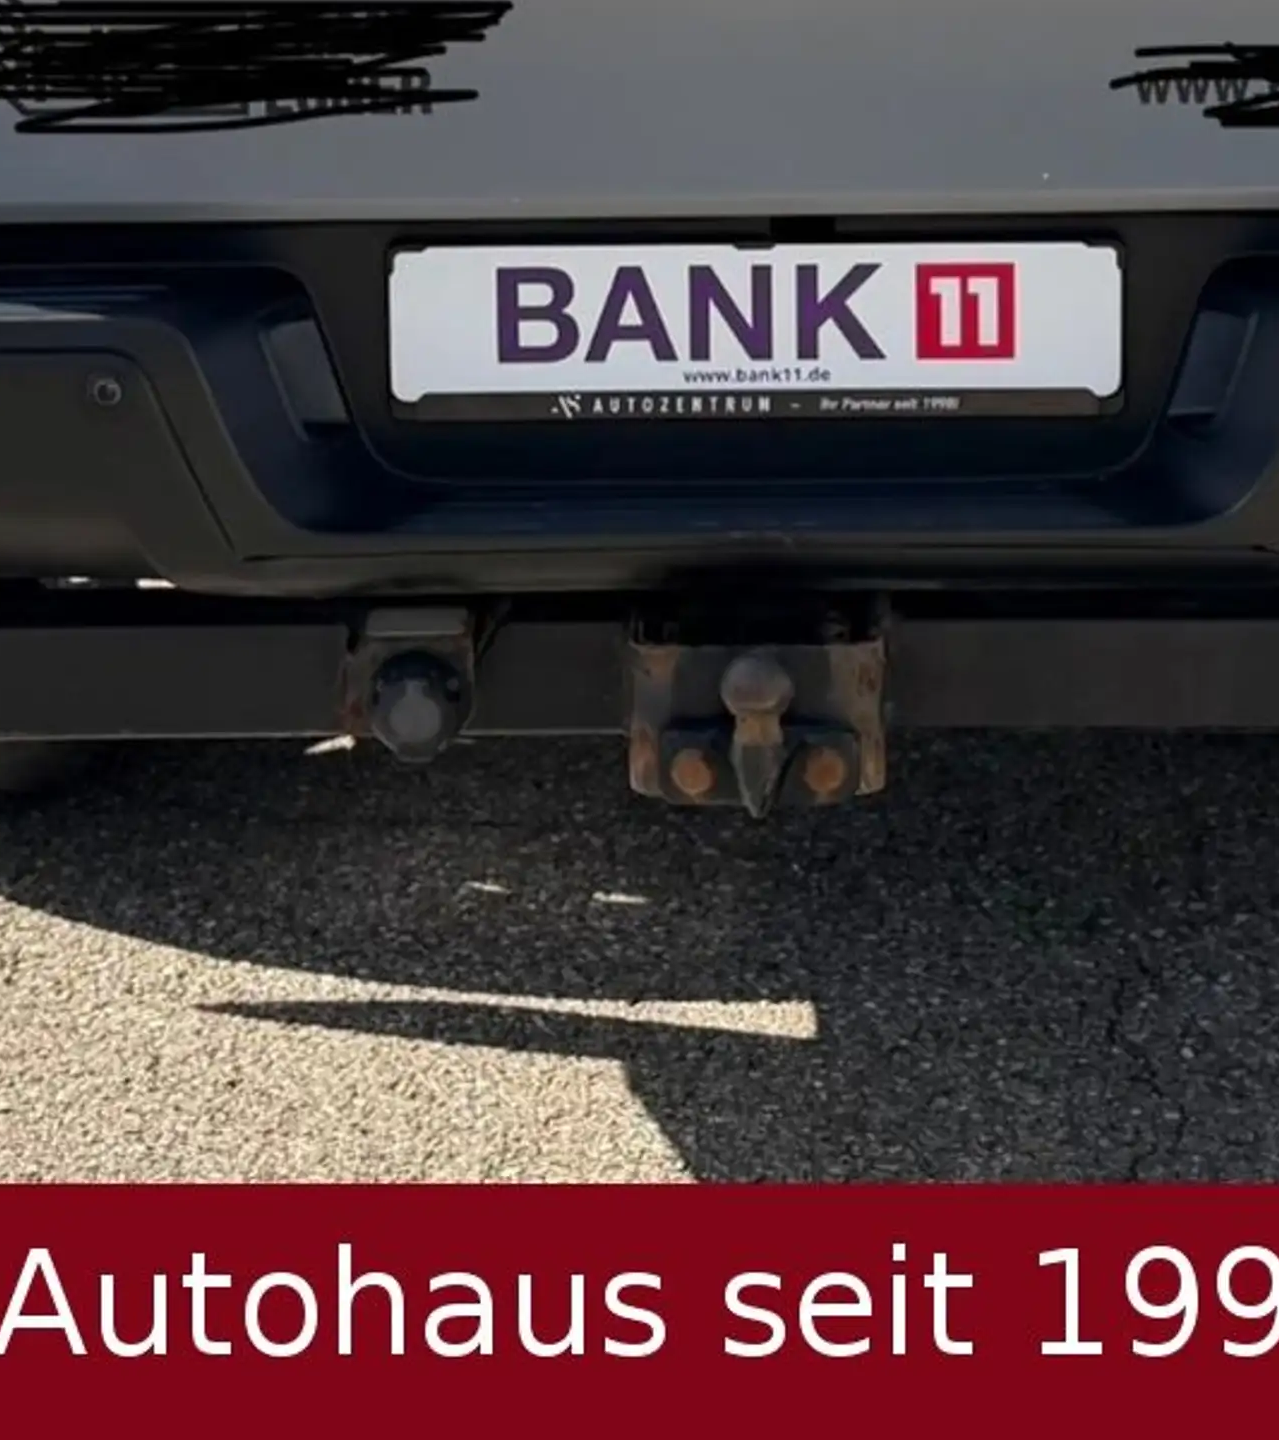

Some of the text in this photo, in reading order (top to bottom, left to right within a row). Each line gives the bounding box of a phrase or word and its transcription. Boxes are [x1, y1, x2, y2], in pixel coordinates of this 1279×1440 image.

[496, 262, 999, 364] BANK 11
[682, 366, 831, 383] www.bank11.de
[592, 395, 771, 414] AUTOZENTRUM
